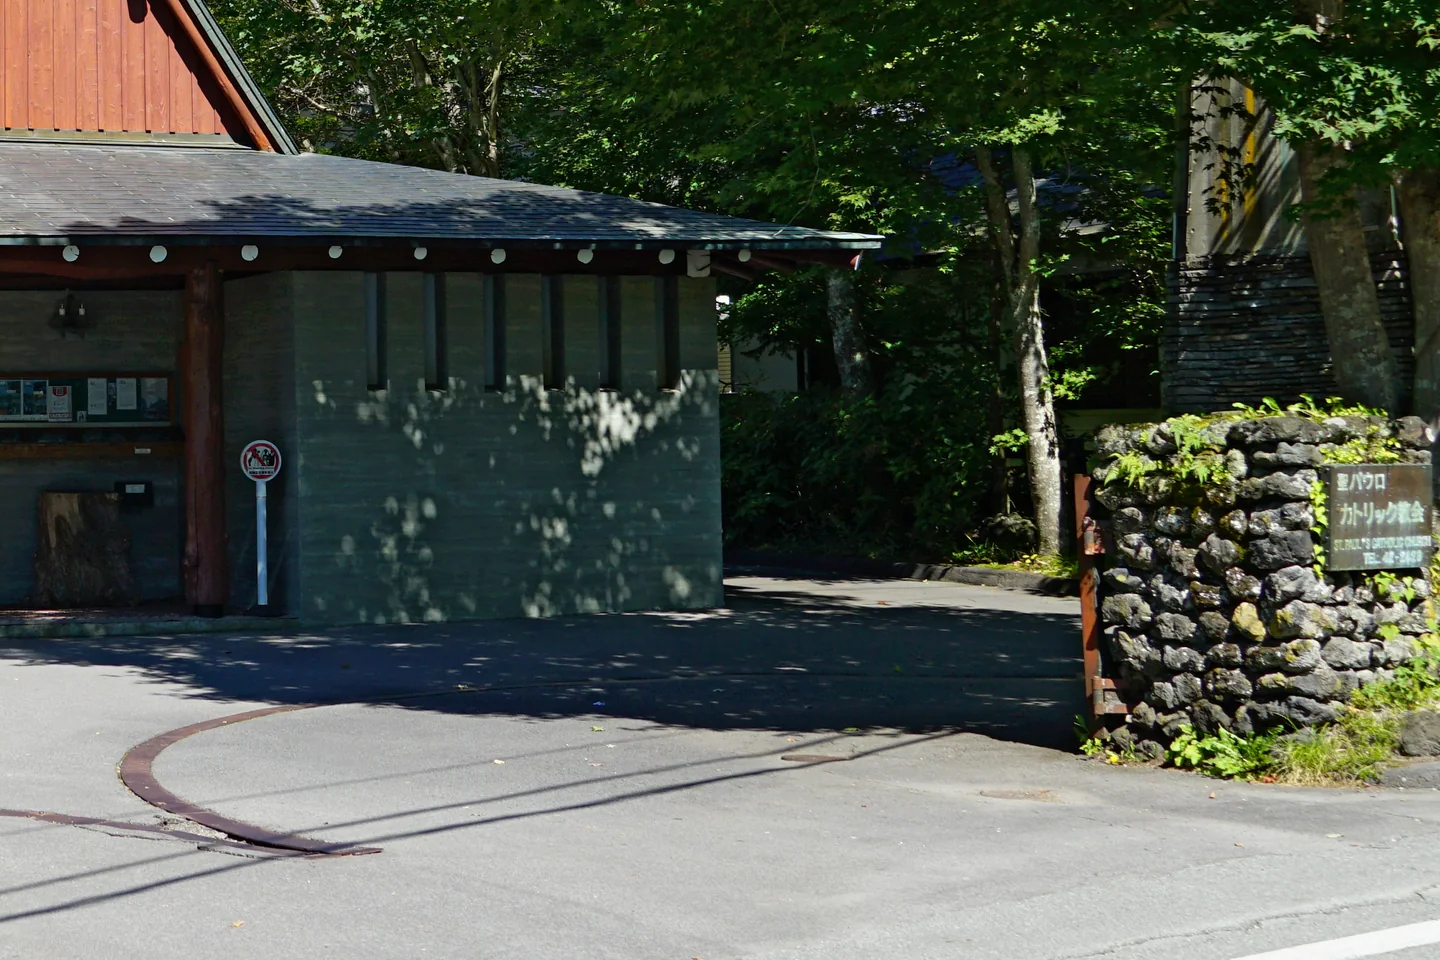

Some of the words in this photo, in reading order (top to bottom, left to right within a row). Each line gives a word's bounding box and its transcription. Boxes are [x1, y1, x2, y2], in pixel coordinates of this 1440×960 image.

[1337, 472, 1386, 491] 聖パウロ
[1339, 500, 1425, 526] カトリック教会
